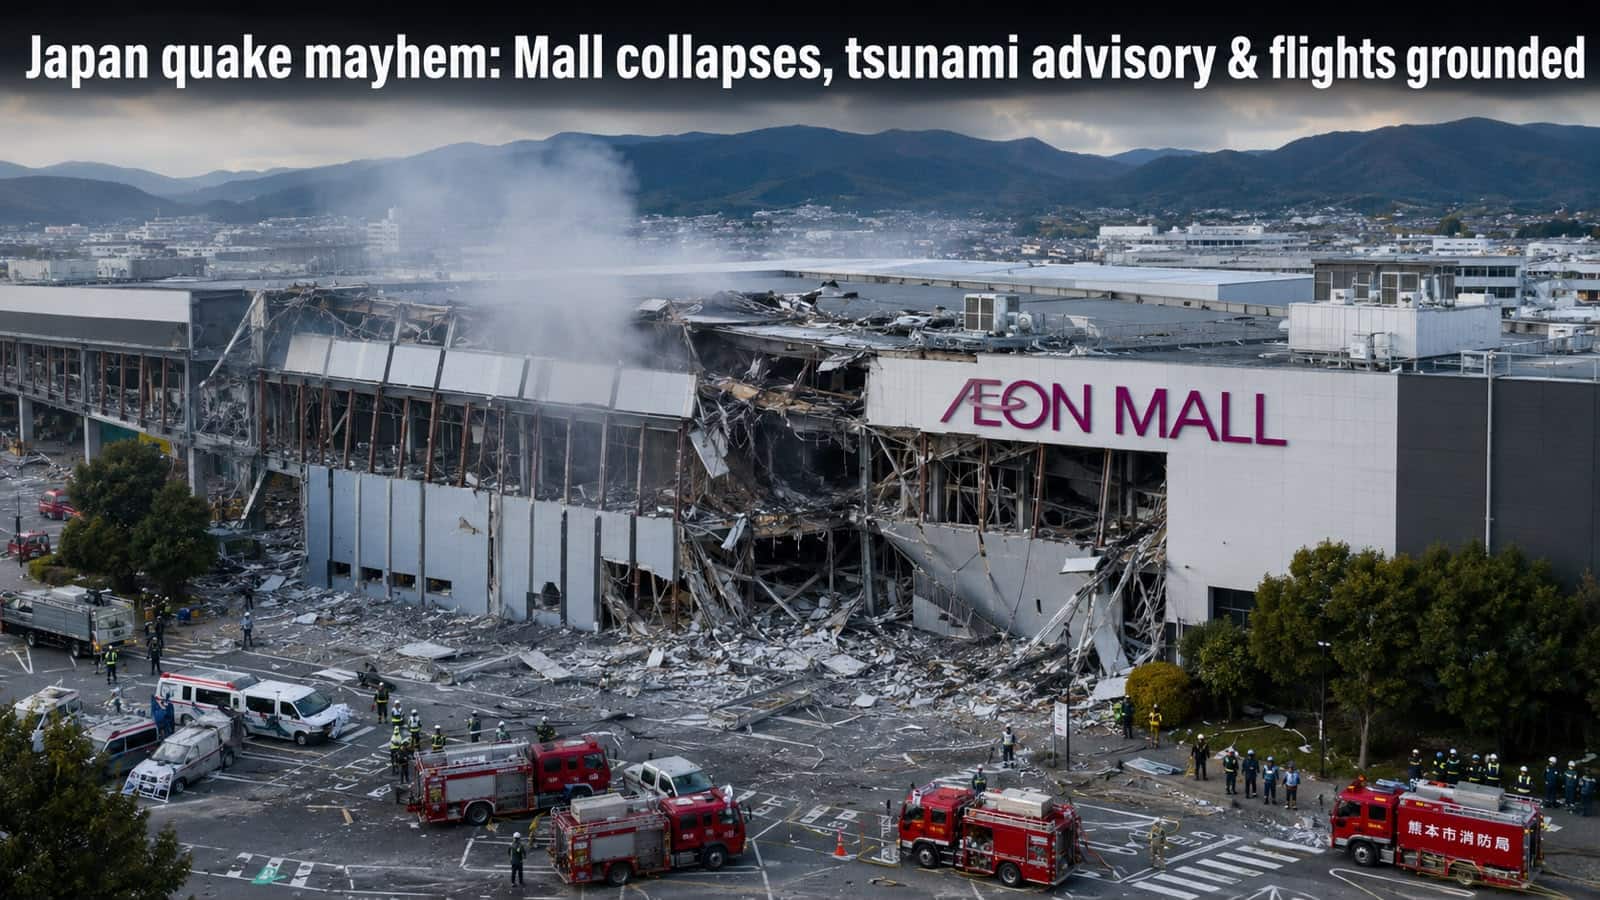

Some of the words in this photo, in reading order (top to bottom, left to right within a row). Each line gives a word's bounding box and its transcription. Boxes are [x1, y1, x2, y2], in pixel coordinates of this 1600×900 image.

[1115, 386, 1287, 447] MALL
[1407, 820, 1511, 851] 熊本市消防局
